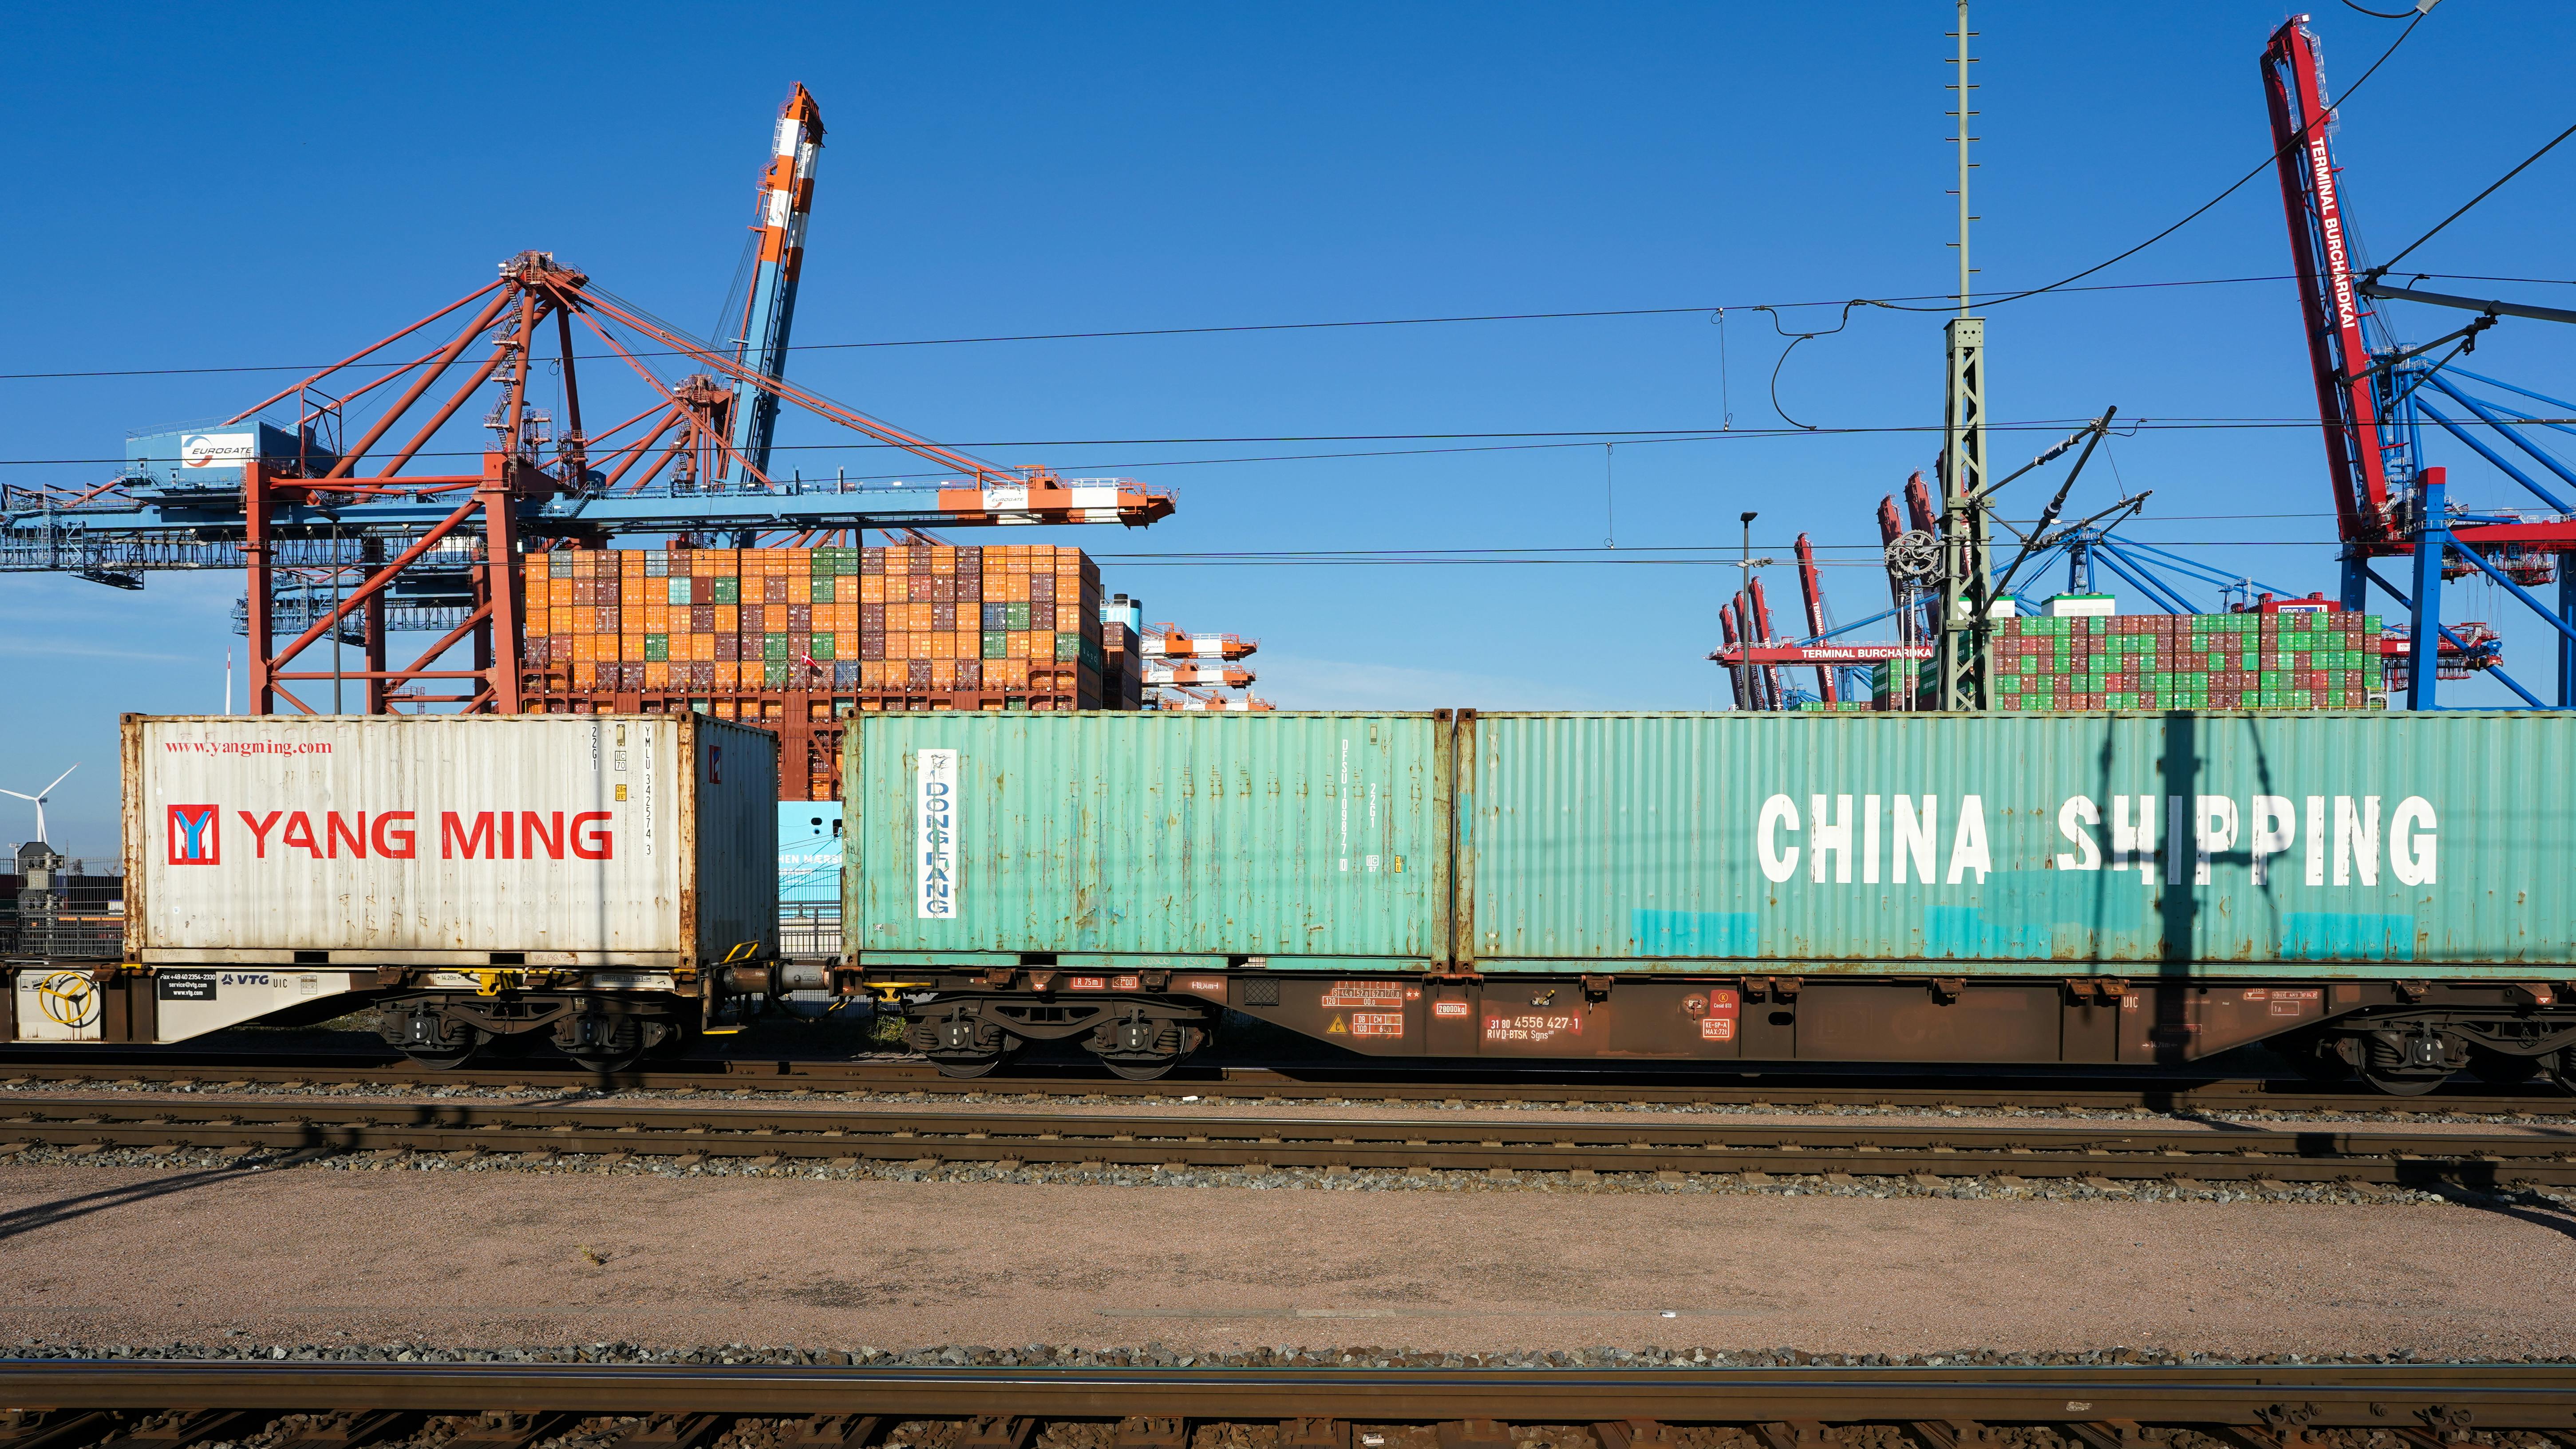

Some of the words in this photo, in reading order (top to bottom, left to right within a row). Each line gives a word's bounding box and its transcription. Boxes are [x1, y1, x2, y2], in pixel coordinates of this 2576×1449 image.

[2311, 136, 2334, 216] TERMINAL
[2324, 217, 2355, 328] BURCHARDKAI
[1802, 649, 1855, 658] TERMINAL
[166, 739, 332, 757] www.yangming.com
[926, 782, 949, 844] DONG
[237, 810, 416, 860] YANG
[442, 811, 613, 860] MING
[1758, 794, 1991, 885] CHINA
[2057, 795, 2438, 886] SHIPPING
[646, 845, 651, 855] 3
[1141, 956, 1170, 965] COSCO
[237, 975, 269, 985] VTG
[273, 979, 288, 988] UIC
[2123, 996, 2138, 1008] UIC
[1335, 1022, 1340, 1031] C
[1491, 1020, 1499, 1029] 31
[1501, 1019, 1510, 1029] 80
[1514, 1017, 1543, 1028] 4556
[1547, 1017, 1578, 1029] 427-1
[1487, 1030, 1501, 1038] RIV
[1501, 1030, 1528, 1040] D-BTSK
